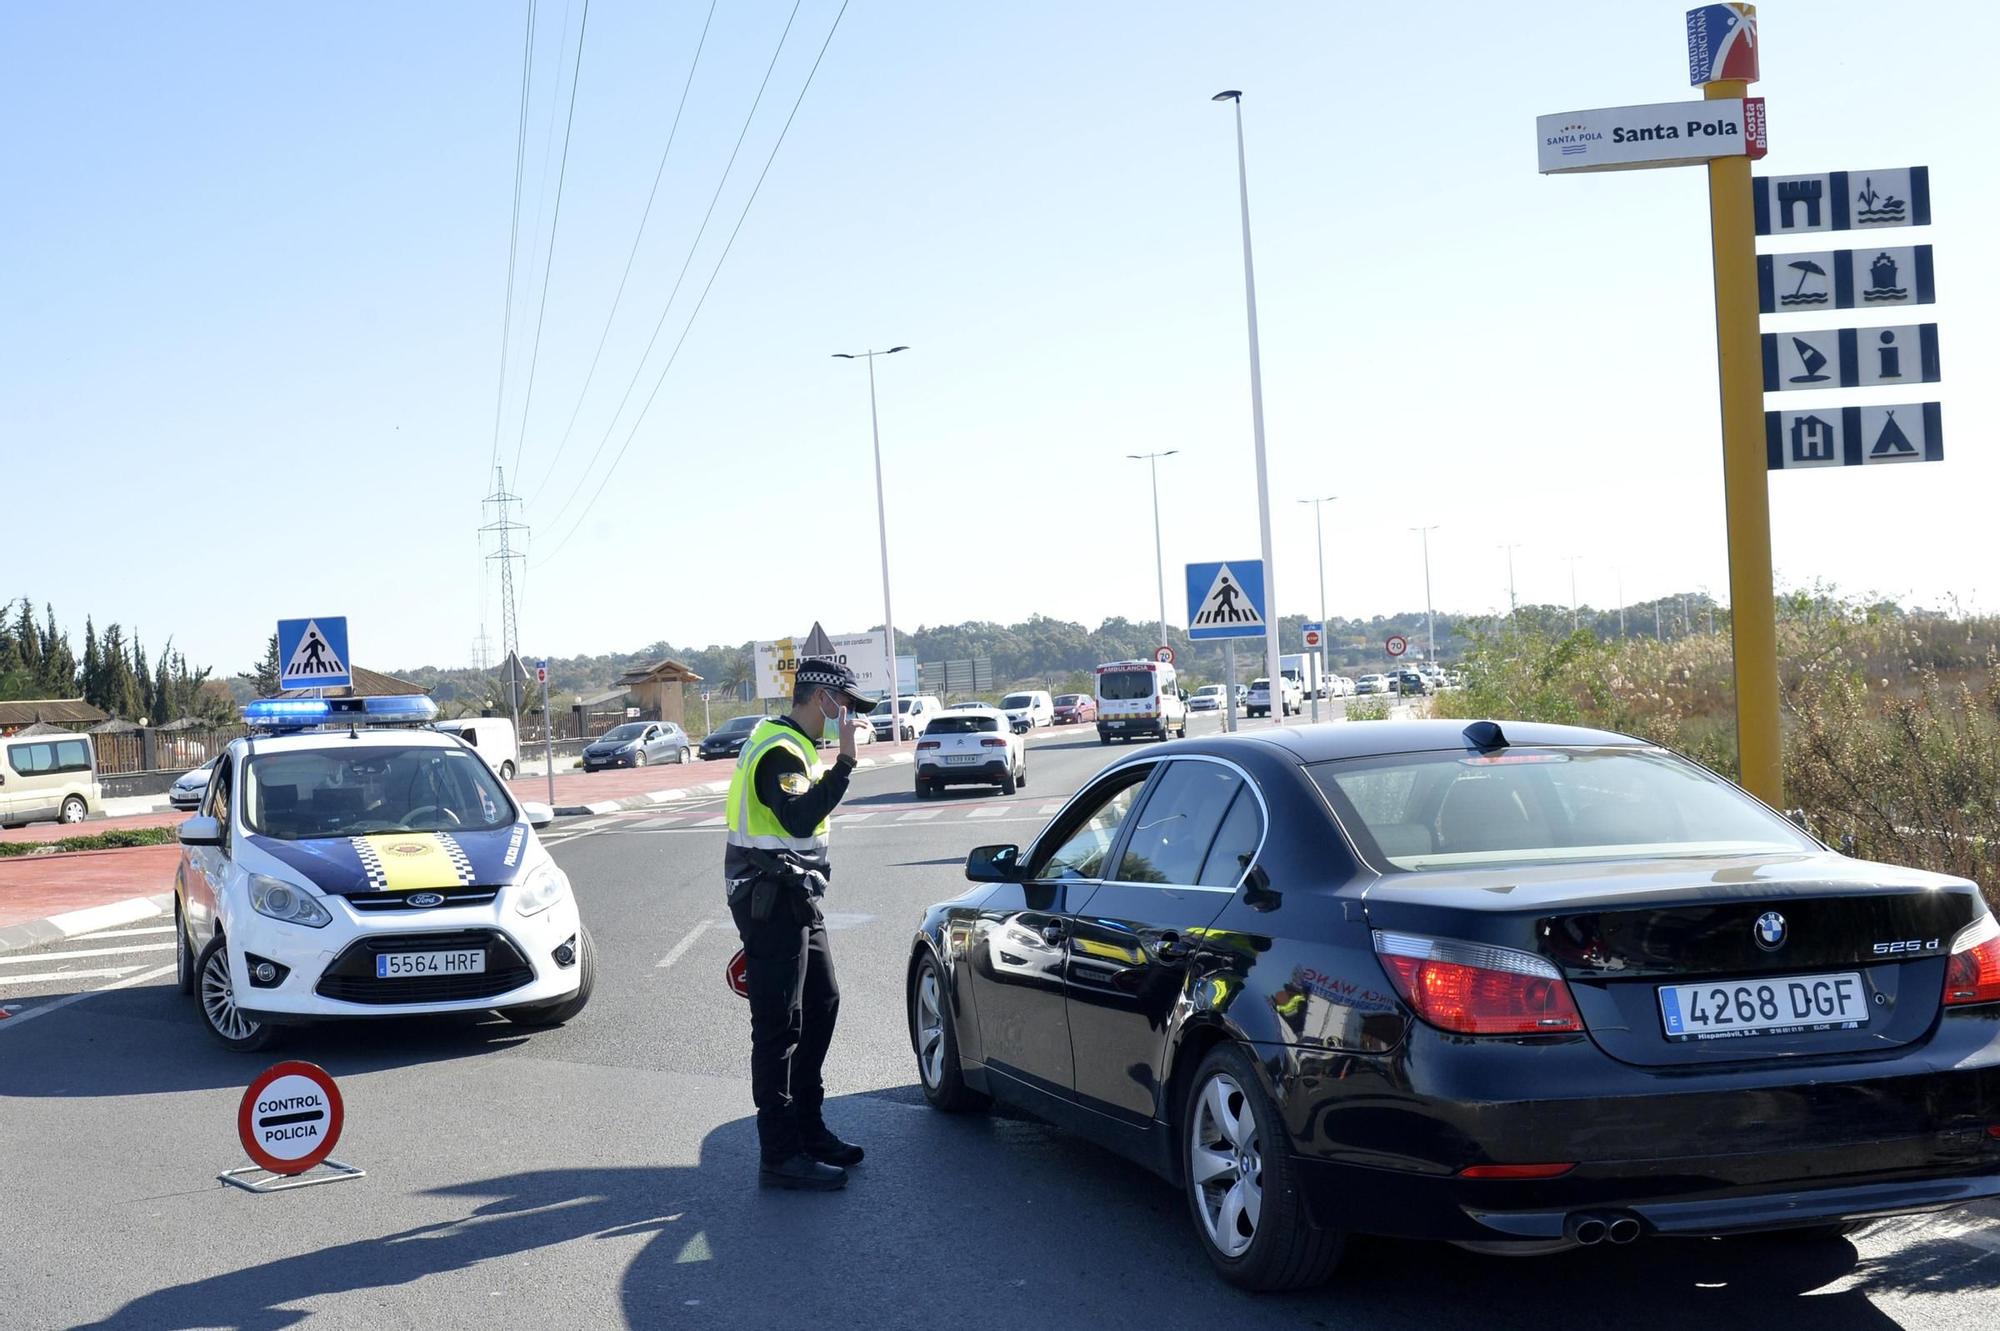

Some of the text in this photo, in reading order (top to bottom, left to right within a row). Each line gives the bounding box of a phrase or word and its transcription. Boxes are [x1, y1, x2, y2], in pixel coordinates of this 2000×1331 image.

[1688, 14, 1699, 82] COMUNITAT
[1696, 10, 1710, 80] VALENCIANA
[1746, 103, 1756, 141] Costa
[1756, 103, 1766, 149] Blanca
[1546, 132, 1602, 146] SANTA POLA
[1612, 120, 1738, 144] Santa Pola
[1391, 642, 1402, 650] 70
[415, 894, 436, 904] Ford
[1873, 938, 1938, 954] 525 d
[390, 953, 480, 973] 5564 HRF
[1690, 980, 1852, 1025] 4268 DGF
[1670, 1016, 1679, 1026] E
[258, 1094, 322, 1113] CONTROL
[265, 1125, 318, 1142] POLICIA
